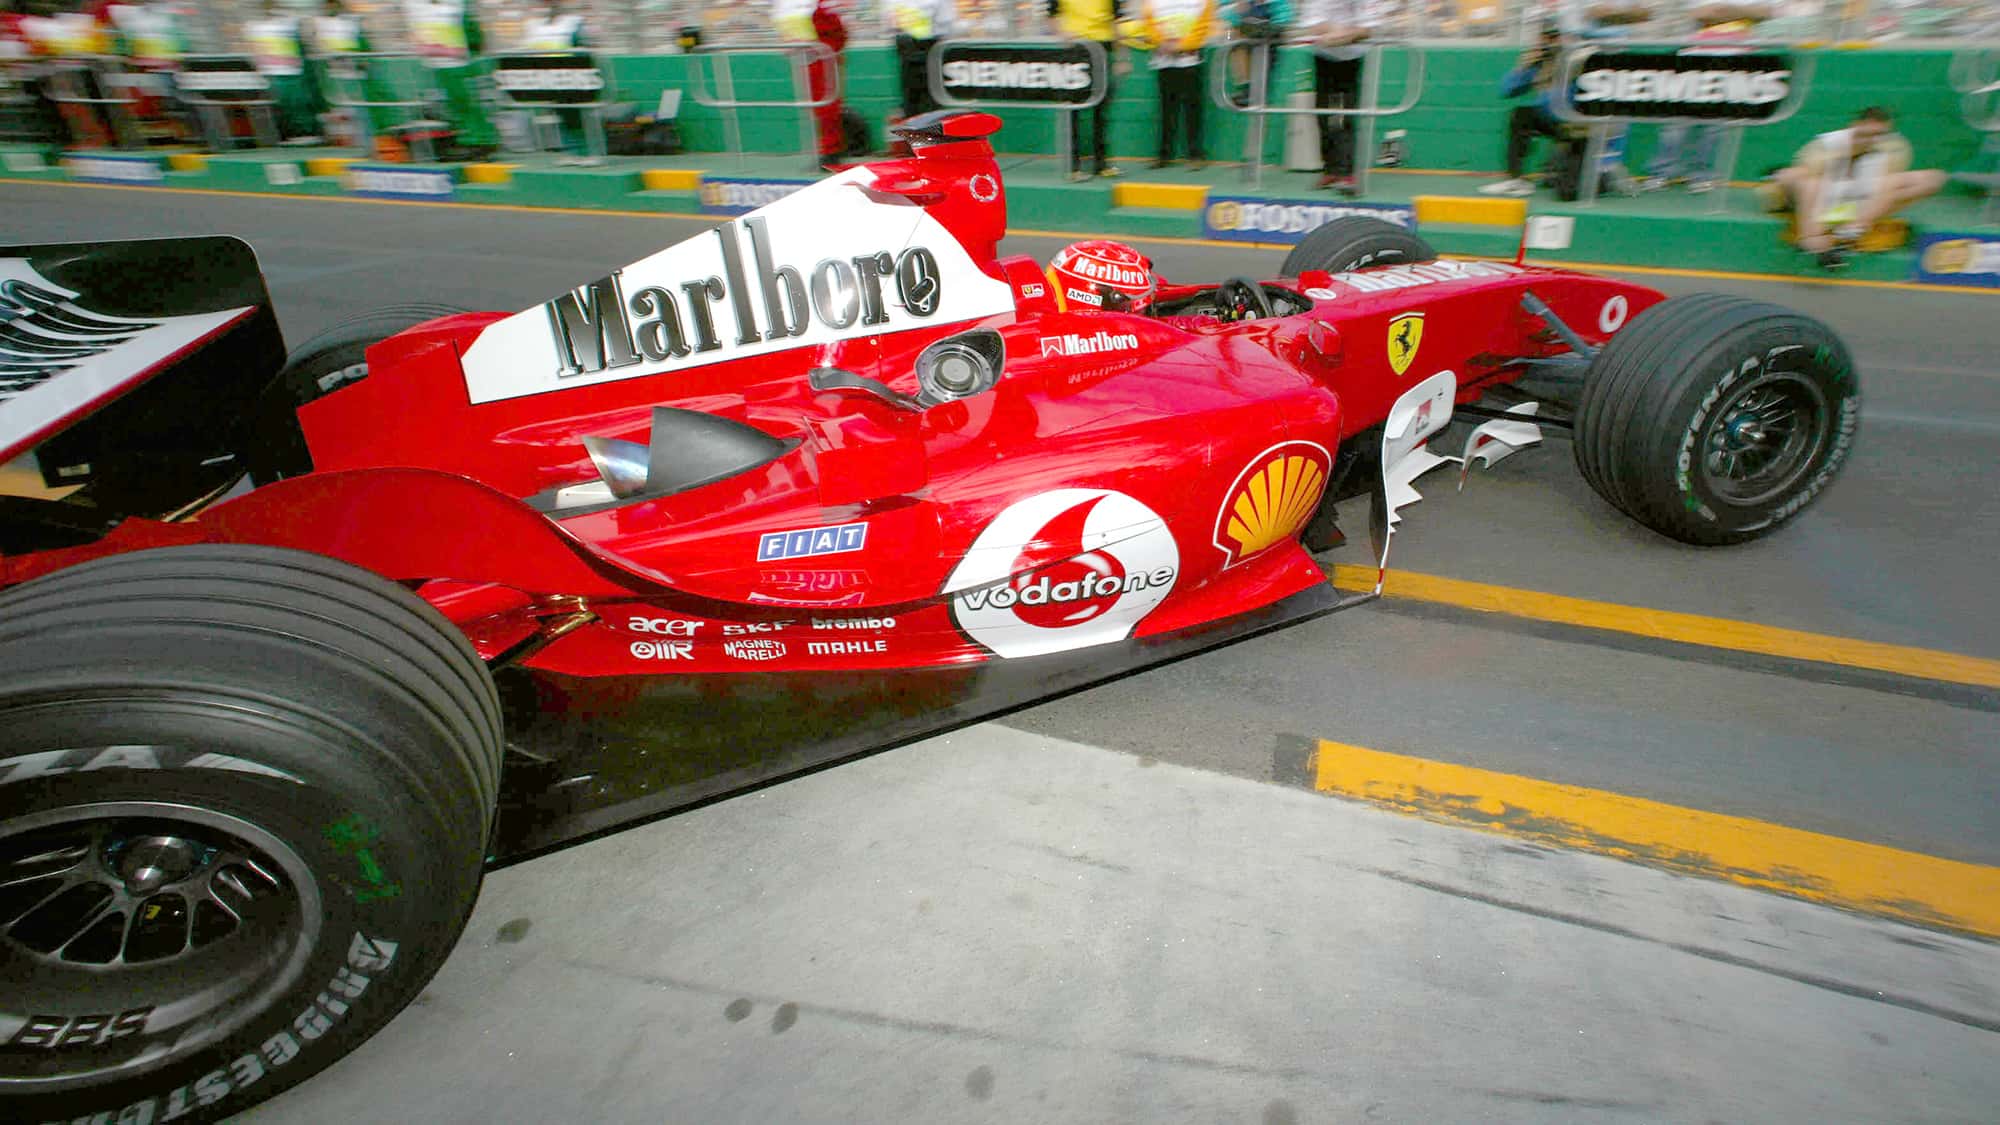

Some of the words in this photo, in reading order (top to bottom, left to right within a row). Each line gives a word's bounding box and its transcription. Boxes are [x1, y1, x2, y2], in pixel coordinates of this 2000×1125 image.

[943, 60, 1092, 89] SIEMENS
[1574, 68, 1793, 105] SIEMENS
[1073, 256, 1144, 285] Marlboro
[547, 215, 942, 380] Marlboro
[1068, 289, 1093, 303] AMD
[1063, 331, 1139, 356] Marlboro
[767, 528, 860, 556] FIAT
[962, 566, 1174, 611] vodafone
[628, 616, 705, 636] acer
[722, 619, 797, 636] SKF
[811, 616, 897, 630] brembo
[807, 640, 889, 655] MAHLE
